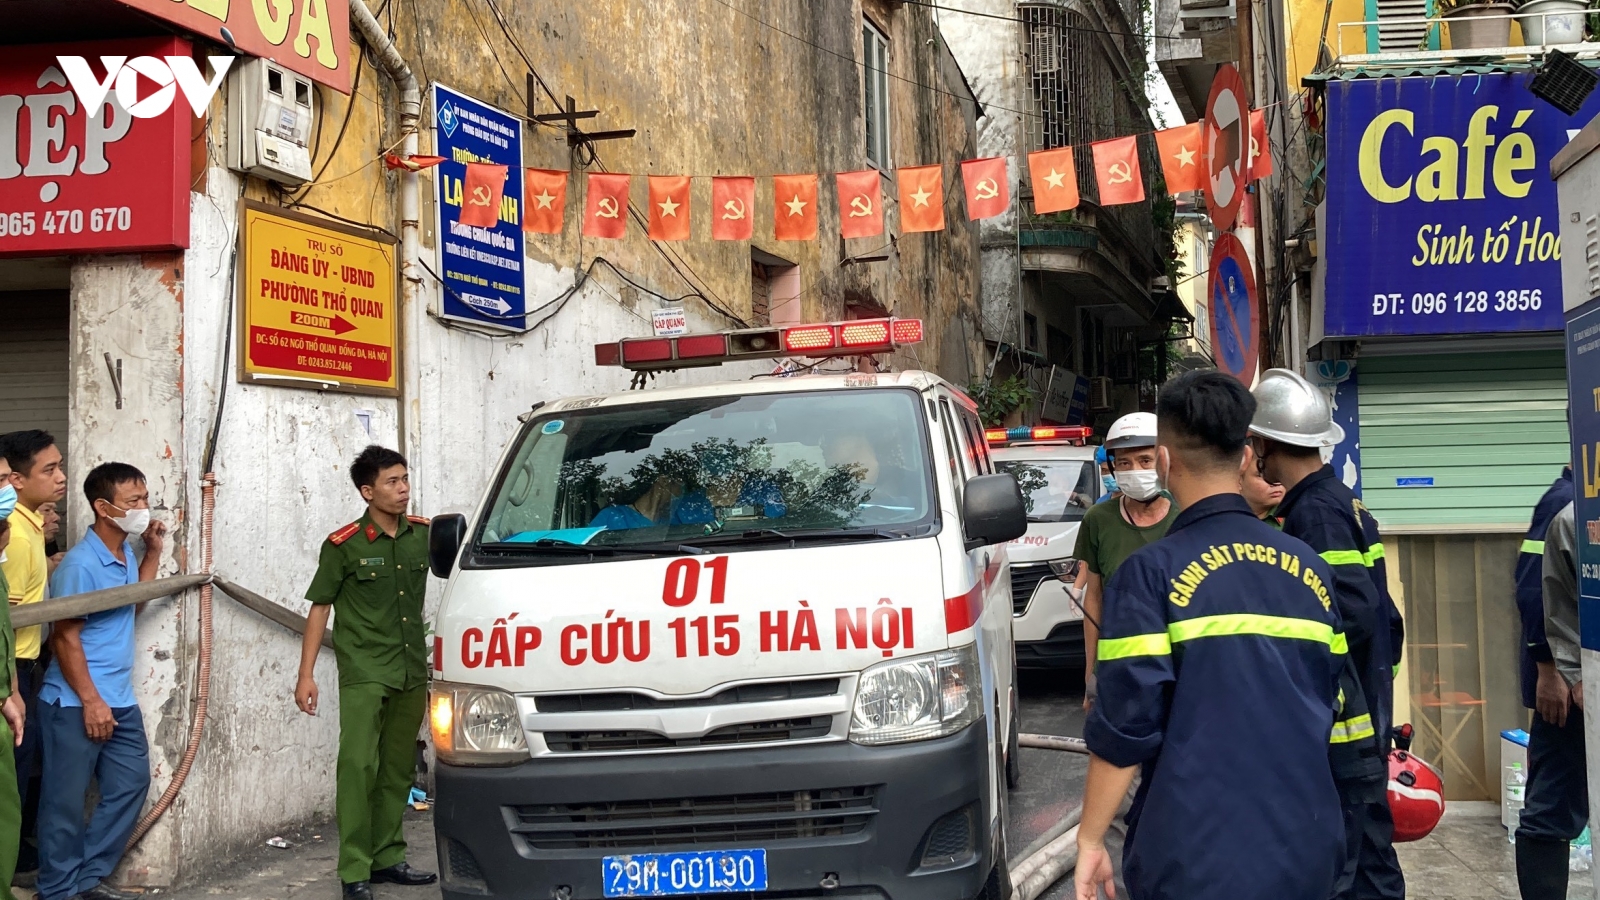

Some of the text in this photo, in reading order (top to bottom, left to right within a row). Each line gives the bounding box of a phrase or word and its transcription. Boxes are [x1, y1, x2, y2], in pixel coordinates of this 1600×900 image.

[1358, 104, 1535, 203] Café
[42, 209, 83, 234] 470
[90, 206, 131, 233] 670
[306, 239, 343, 256] TRỤ SỞ
[1412, 224, 1475, 267] Sinh
[1482, 215, 1518, 263] tố
[270, 246, 308, 275] ĐẢNG
[312, 254, 329, 278] ỦY
[340, 265, 375, 288] UBND
[260, 279, 384, 319] PHƯỜNG THỔ QUAN
[469, 295, 498, 308] Cách 250m
[1372, 289, 1542, 316] ĐT: 096 128 3856
[295, 314, 330, 329] 200M
[666, 318, 685, 329] QUANG
[269, 332, 278, 346] SỐ
[280, 338, 288, 347] 62
[290, 338, 304, 349] NGÕ
[319, 343, 336, 354] QUAN
[368, 349, 376, 360] HÀ
[308, 357, 352, 371] 0243.851.2446
[1024, 535, 1049, 546] NỘI
[662, 556, 729, 608] 01
[1168, 561, 1209, 608] CẢNH
[1200, 545, 1234, 571] SÁT
[1232, 543, 1277, 565] PCCC
[1280, 551, 1300, 577] VÀ
[460, 597, 914, 669] CẤP CỨU 115 HÀ NỘI
